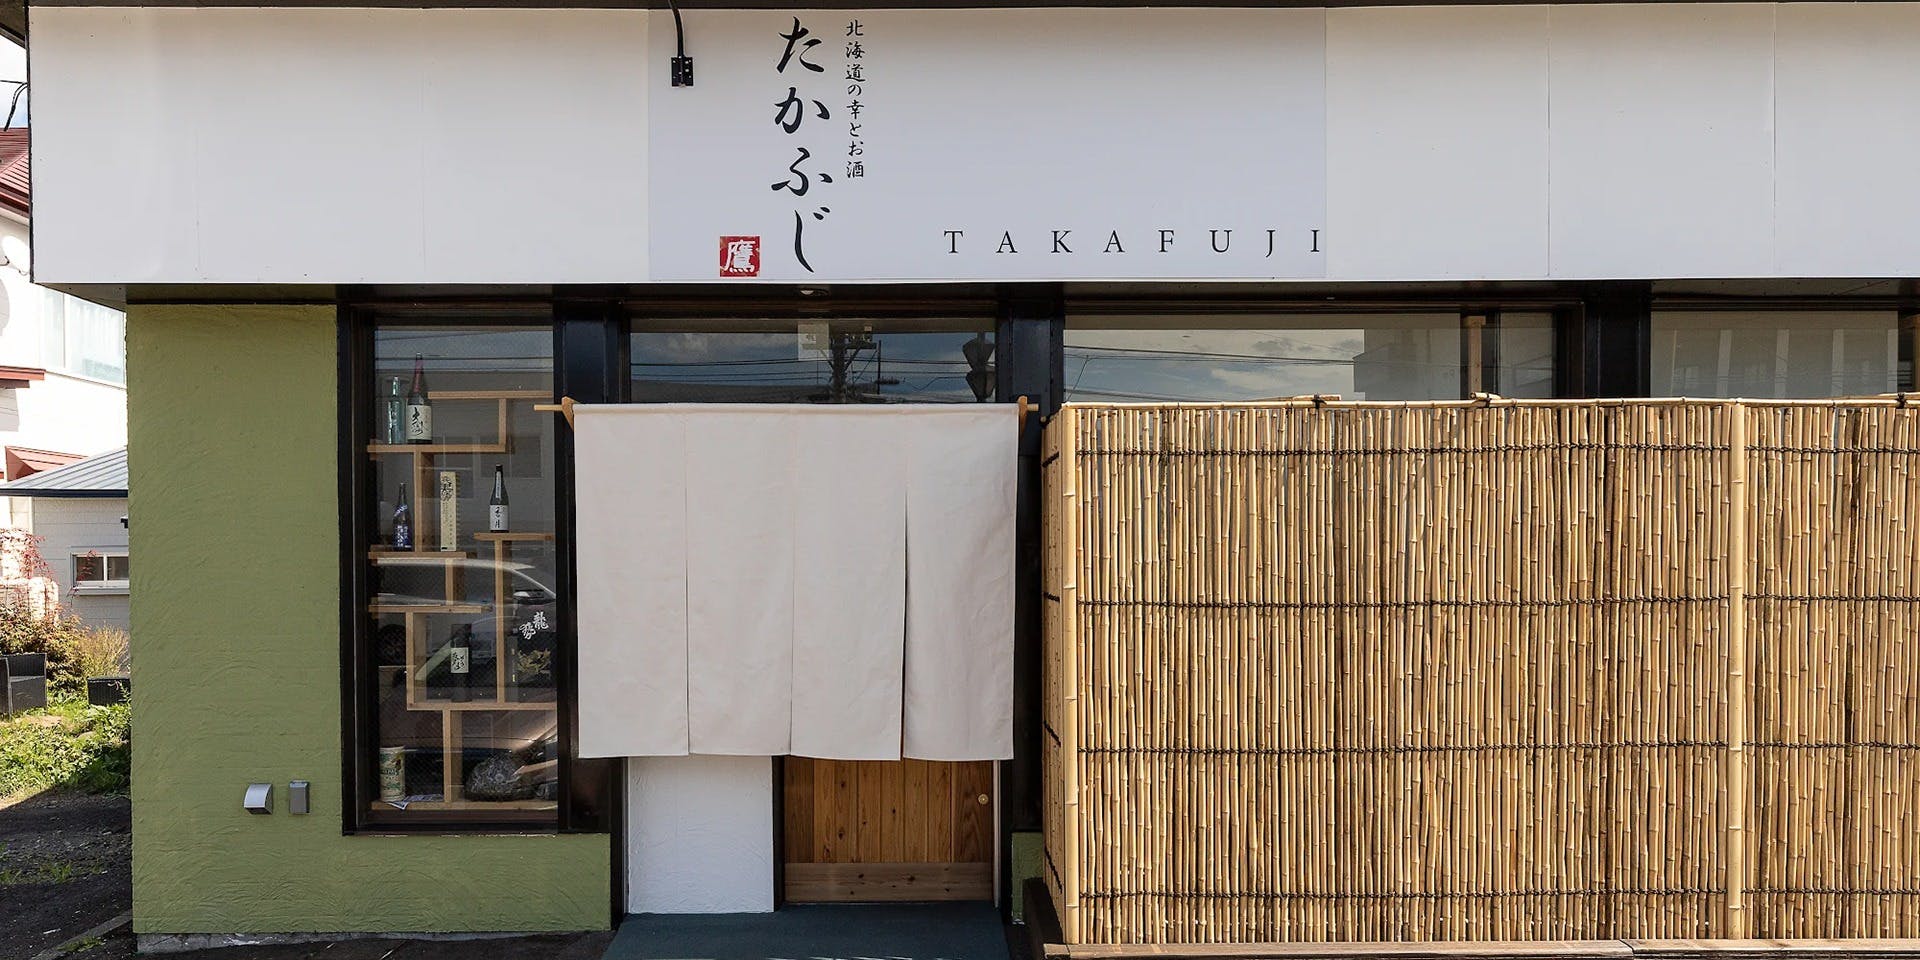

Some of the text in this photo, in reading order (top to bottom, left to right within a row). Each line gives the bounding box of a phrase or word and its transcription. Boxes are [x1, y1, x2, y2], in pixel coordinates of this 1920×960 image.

[771, 16, 833, 274] たかふじ
[844, 19, 866, 179] 北海道の幸とお酒
[721, 238, 760, 275] 鷹
[943, 229, 1321, 258] TAKAFUJI
